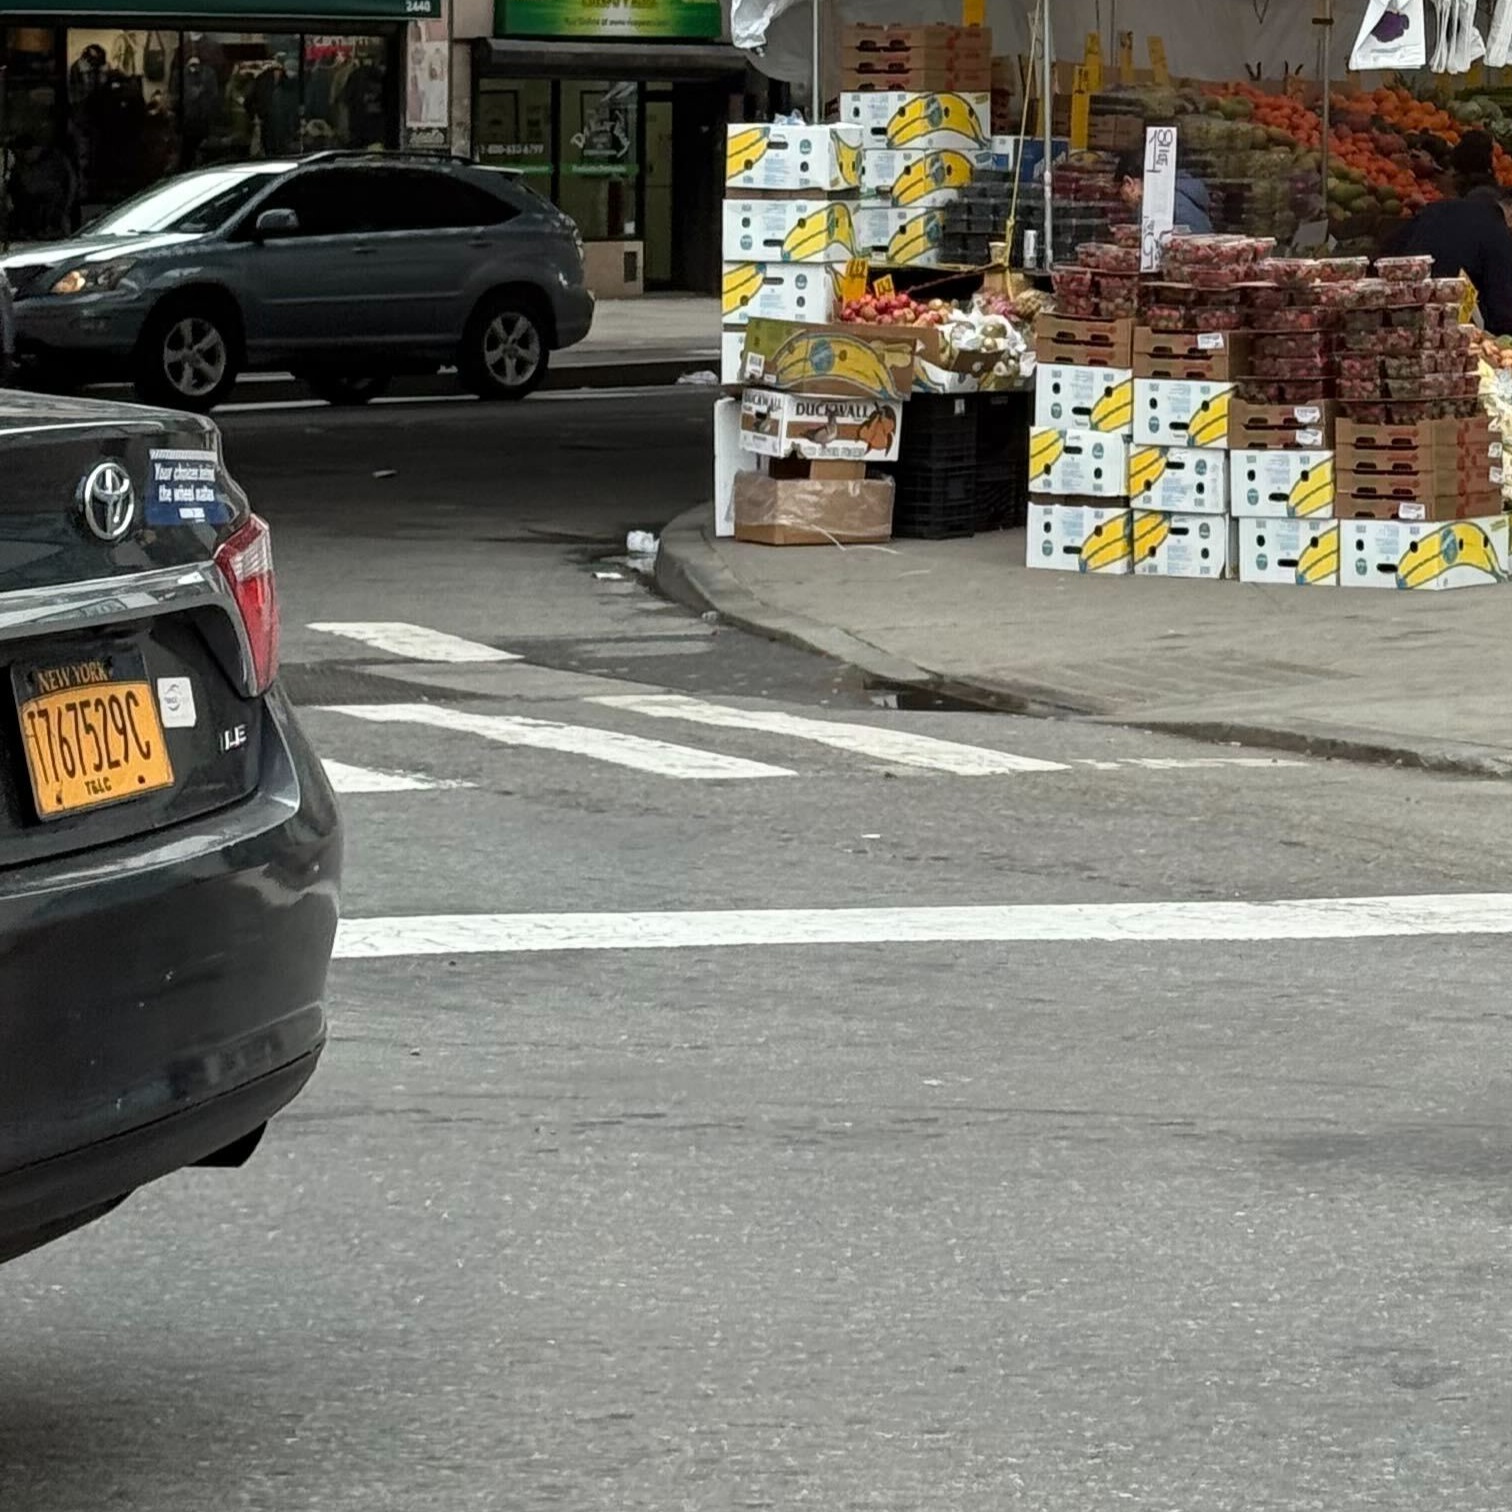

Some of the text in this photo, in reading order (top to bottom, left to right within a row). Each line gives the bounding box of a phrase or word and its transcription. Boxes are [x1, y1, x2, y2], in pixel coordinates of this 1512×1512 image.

[795, 402, 870, 419] DUCKWALL
[37, 660, 108, 693] NEW YORK
[27, 690, 152, 785] T767529C
[223, 724, 248, 751] LE
